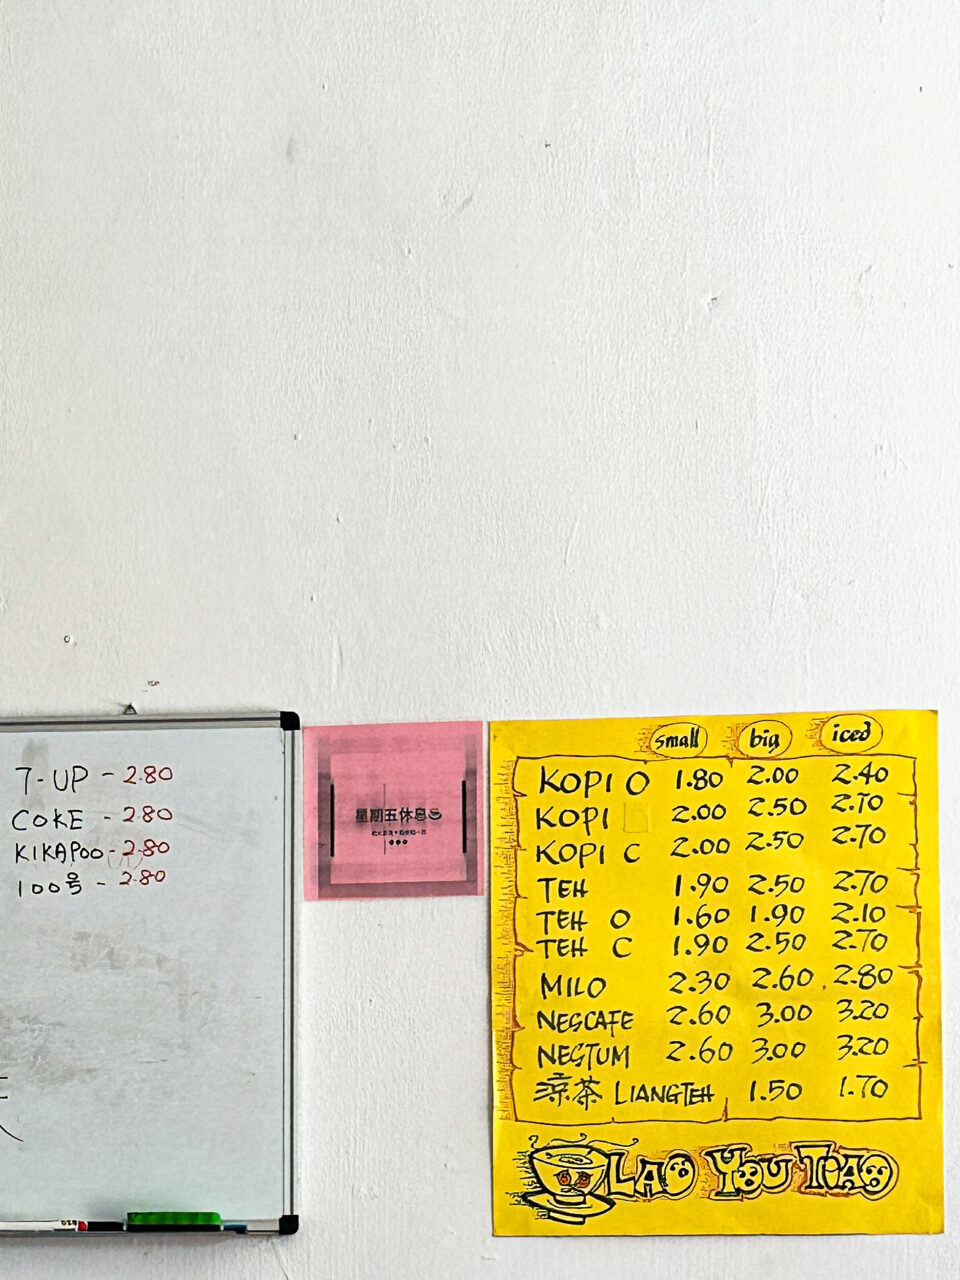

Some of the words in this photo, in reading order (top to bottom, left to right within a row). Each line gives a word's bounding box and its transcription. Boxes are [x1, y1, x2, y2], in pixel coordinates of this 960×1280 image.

[654, 726, 700, 749] small
[749, 728, 781, 754] big
[832, 721, 872, 743] iced
[539, 765, 613, 799] KOPI
[625, 771, 650, 796] O
[675, 768, 724, 790] 1.80
[746, 765, 799, 785] 2.00
[832, 761, 889, 785] 2.40
[11, 808, 84, 831] COKE
[535, 806, 609, 836] KOPI
[671, 804, 727, 823] 2.00
[748, 797, 807, 817] 2.50
[831, 792, 884, 814] 2.70
[535, 839, 605, 869] KOPI
[623, 843, 641, 864] C
[670, 837, 731, 858] 2.00
[745, 831, 805, 851] 2.50
[832, 823, 887, 849] 2.70
[536, 877, 589, 904] TEH
[674, 873, 729, 899] 1.90
[747, 874, 805, 897] 2.50
[833, 869, 889, 896] 2.70
[535, 909, 588, 936] TEH
[609, 908, 631, 930] O
[674, 904, 730, 929] 1.60
[750, 904, 805, 927] 1.90
[831, 902, 886, 924] 2.10
[535, 936, 588, 960] TEH
[612, 936, 633, 959] C
[674, 933, 728, 957] 1.90
[745, 932, 807, 955] 2.50
[832, 928, 888, 953] 2.70
[540, 972, 607, 1000] MILO
[668, 970, 731, 995] 2.30
[751, 964, 814, 991] 2.60
[833, 963, 893, 990] 2.80
[666, 1001, 731, 1026] 2.60
[756, 1001, 813, 1028] 3.00
[836, 998, 889, 1023] 3.20
[665, 1035, 734, 1064] 2.60
[751, 1037, 806, 1064] 3.00
[836, 1034, 889, 1061] 3.20
[749, 1079, 803, 1102] 1.50
[839, 1074, 888, 1099] 1.70
[604, 1148, 697, 1200] LAO
